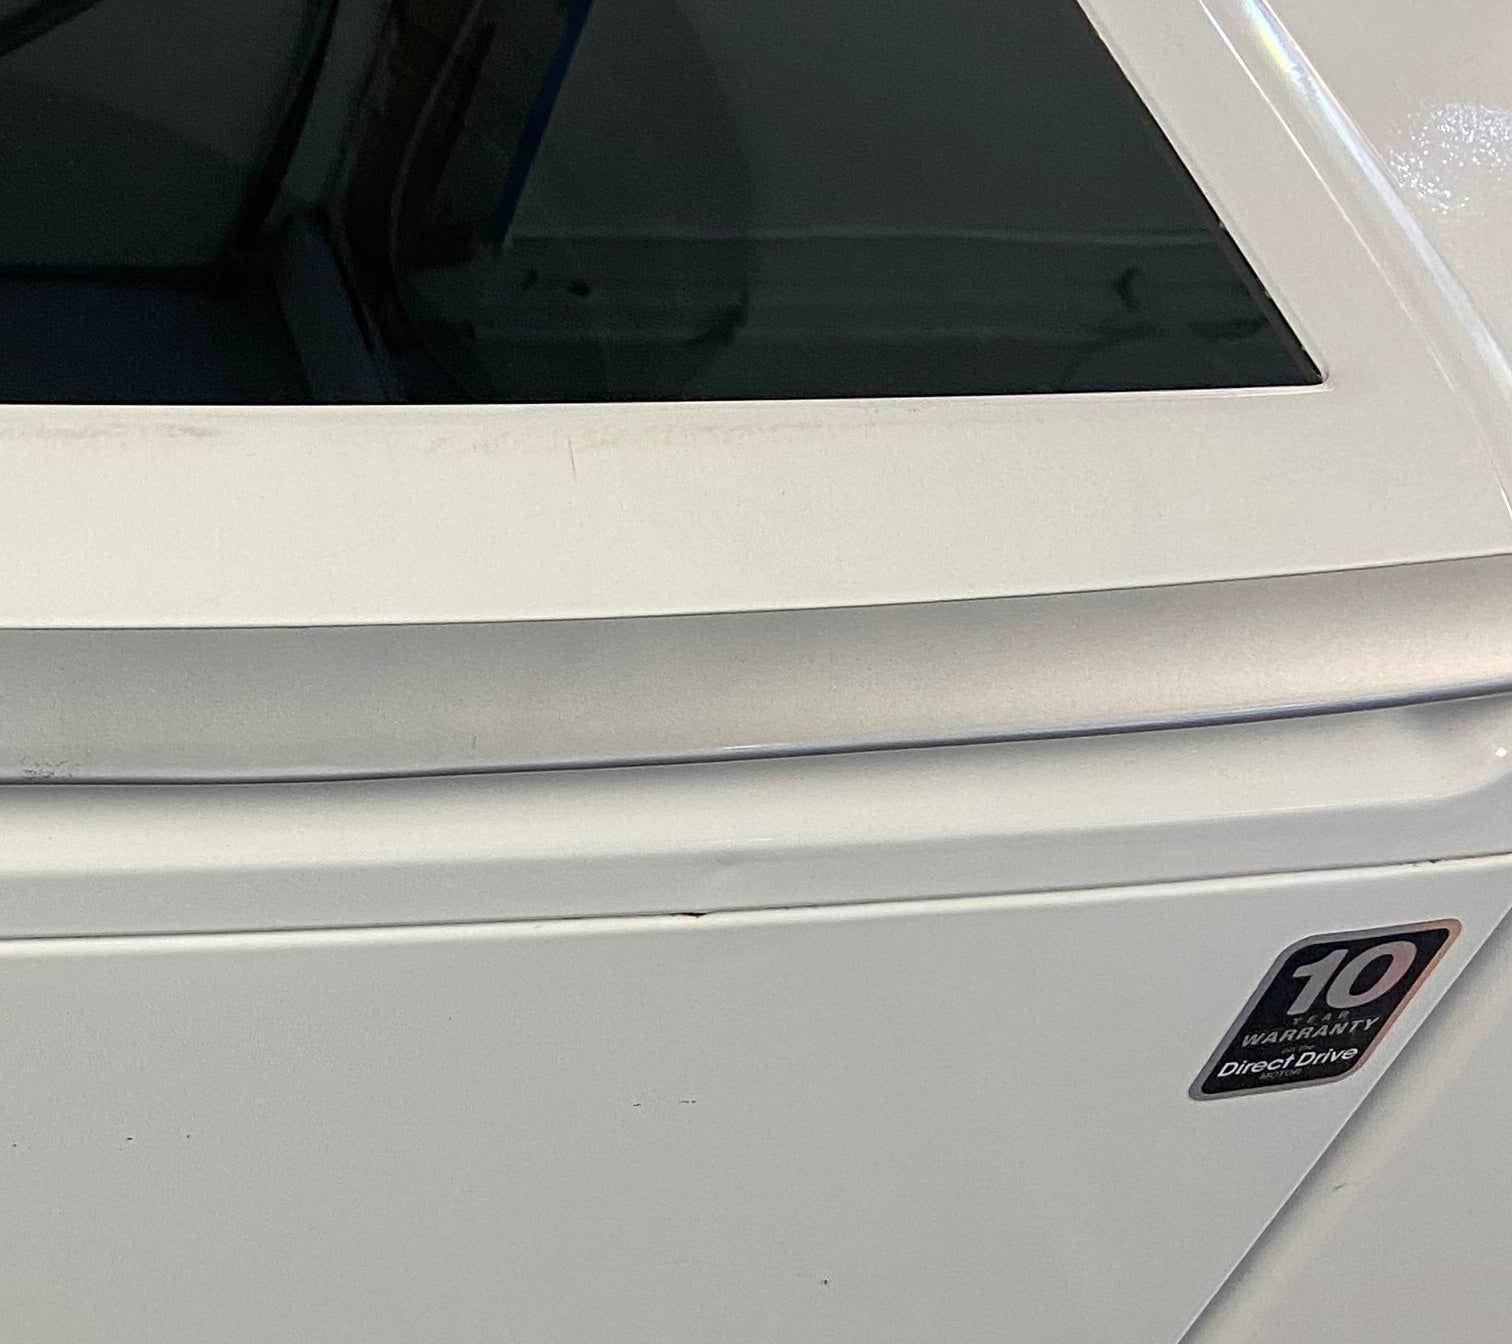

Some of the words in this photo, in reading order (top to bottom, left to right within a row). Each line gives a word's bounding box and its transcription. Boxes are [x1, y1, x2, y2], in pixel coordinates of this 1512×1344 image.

[1287, 940, 1418, 1016] 10
[1241, 1016, 1380, 1048] WARRANTY
[1292, 1010, 1351, 1026] YEAR
[1217, 1053, 1296, 1078] Direct
[1295, 1047, 1359, 1069] Drive
